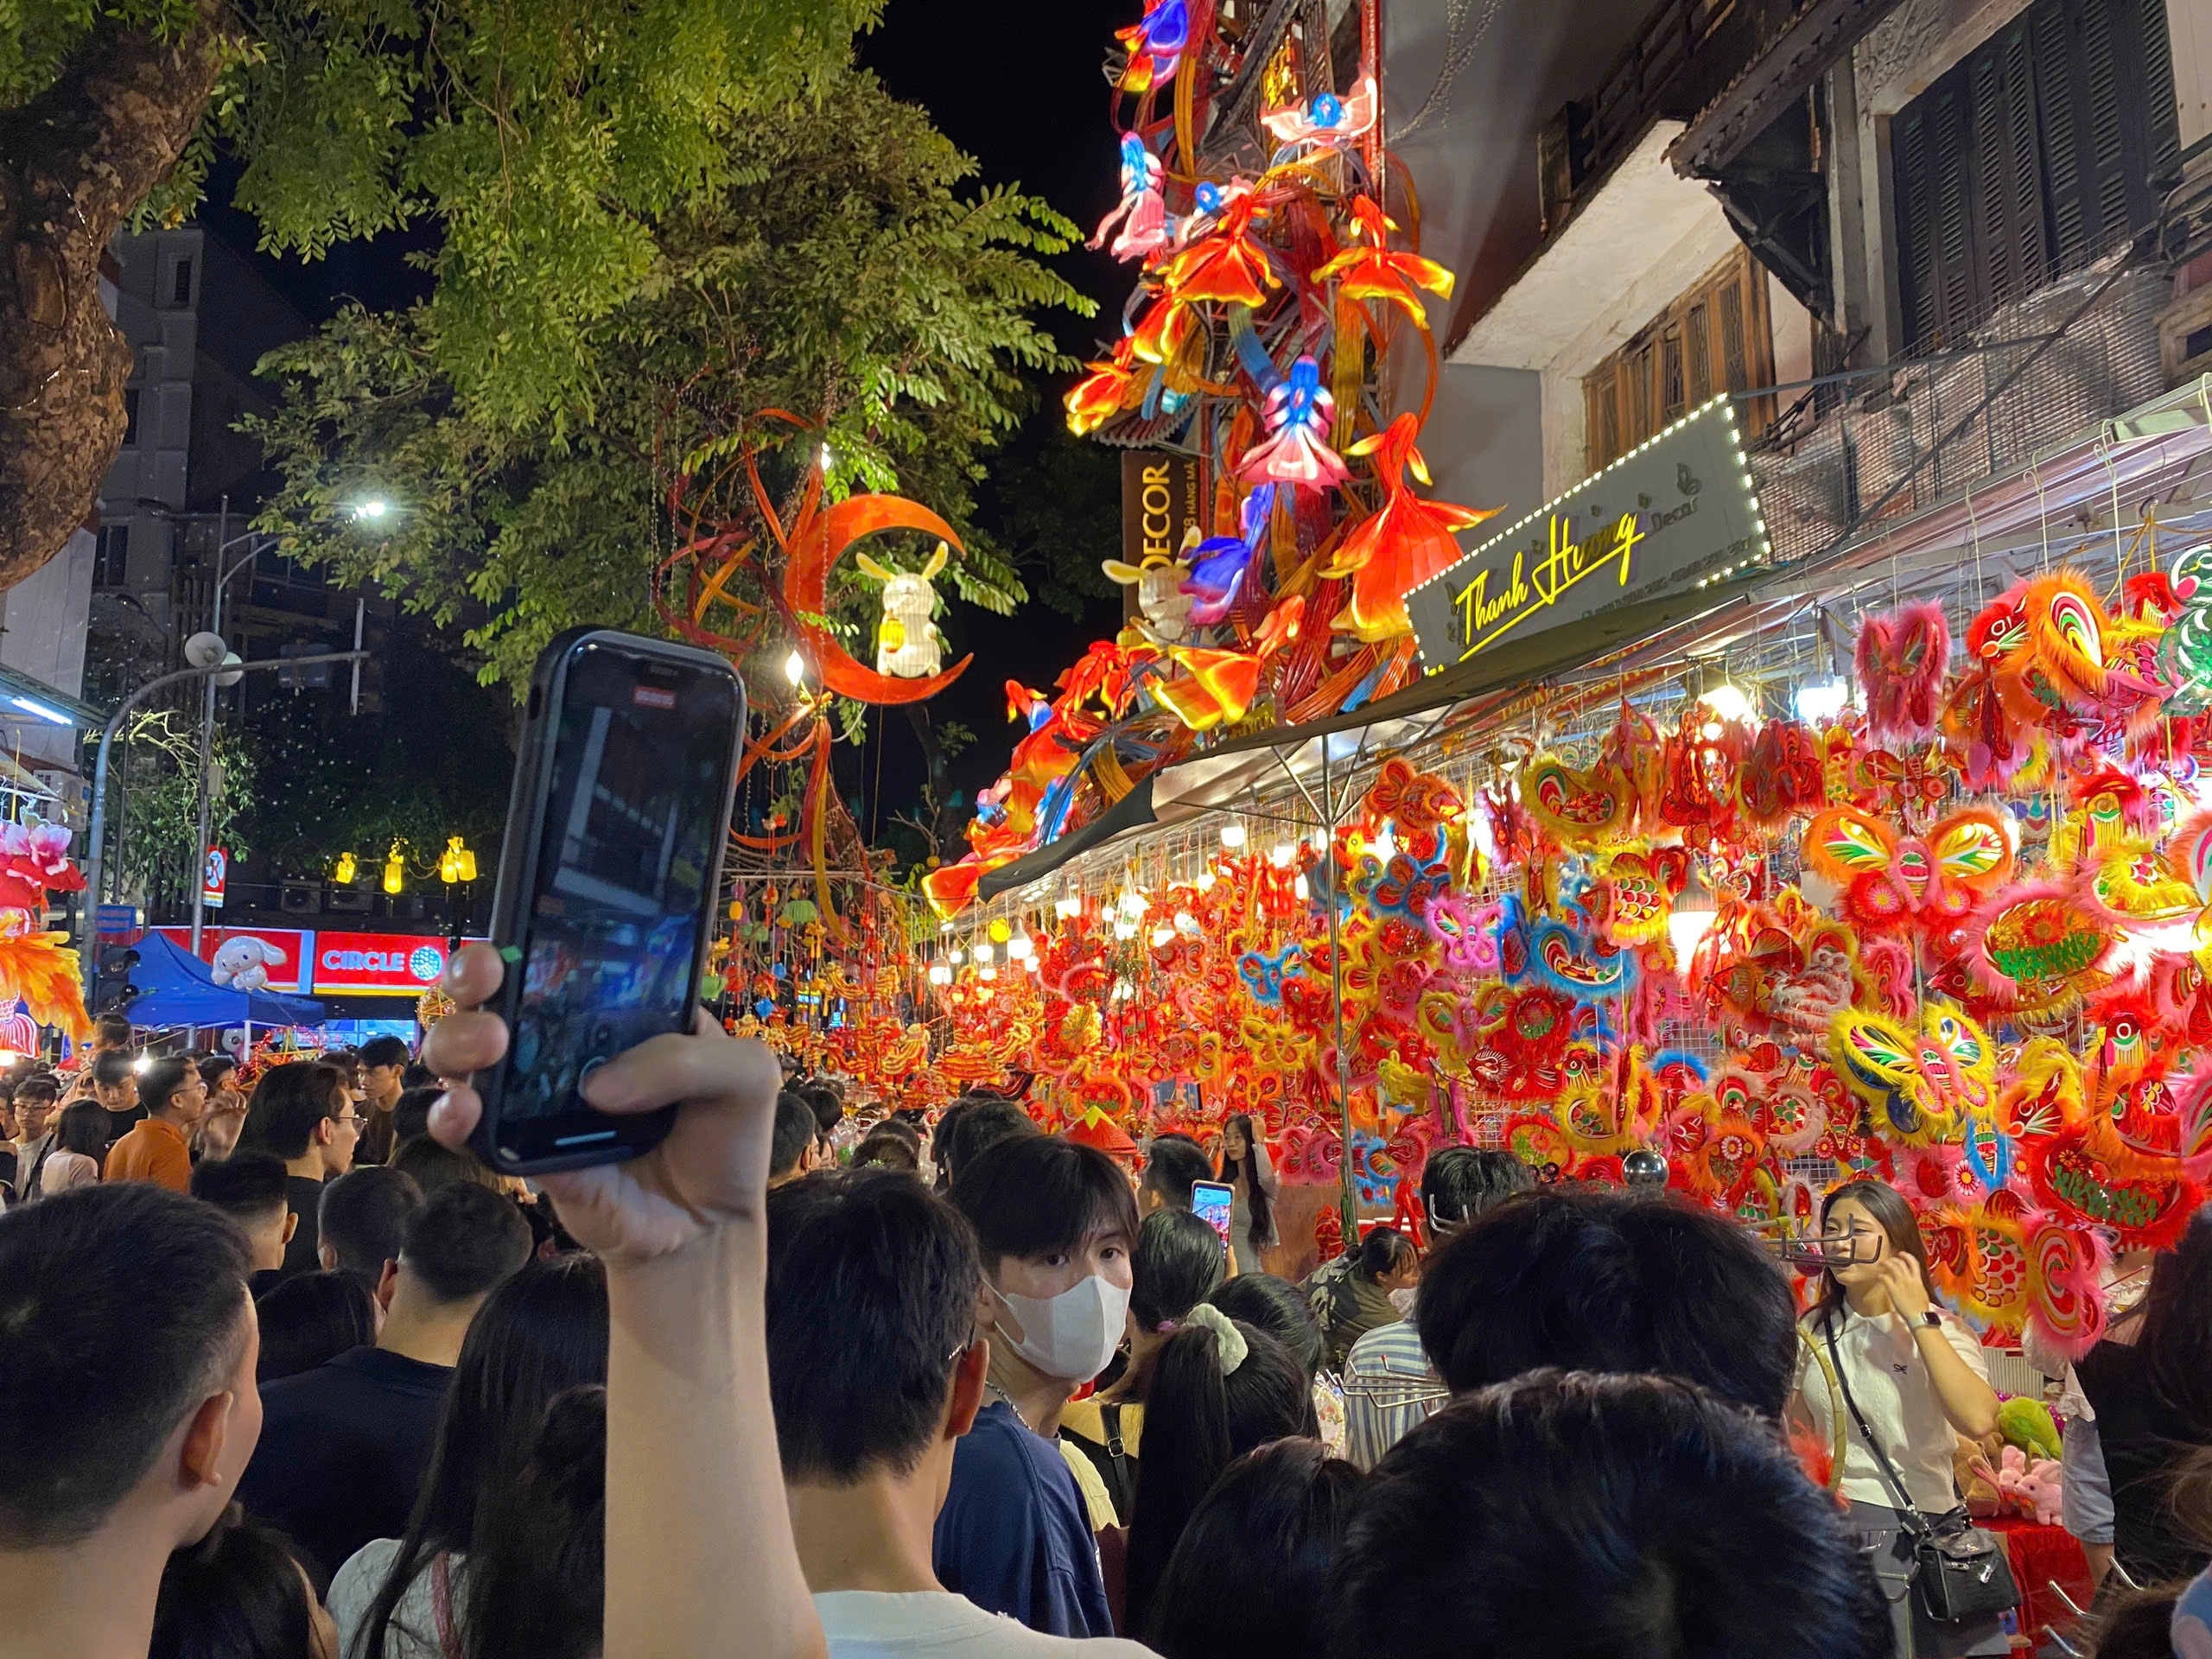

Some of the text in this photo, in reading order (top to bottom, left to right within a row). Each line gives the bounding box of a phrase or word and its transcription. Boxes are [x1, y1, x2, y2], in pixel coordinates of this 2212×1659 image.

[1651, 497, 1697, 532] Decor
[1456, 551, 1528, 645] Thanh
[322, 950, 404, 971] CIRCLE
